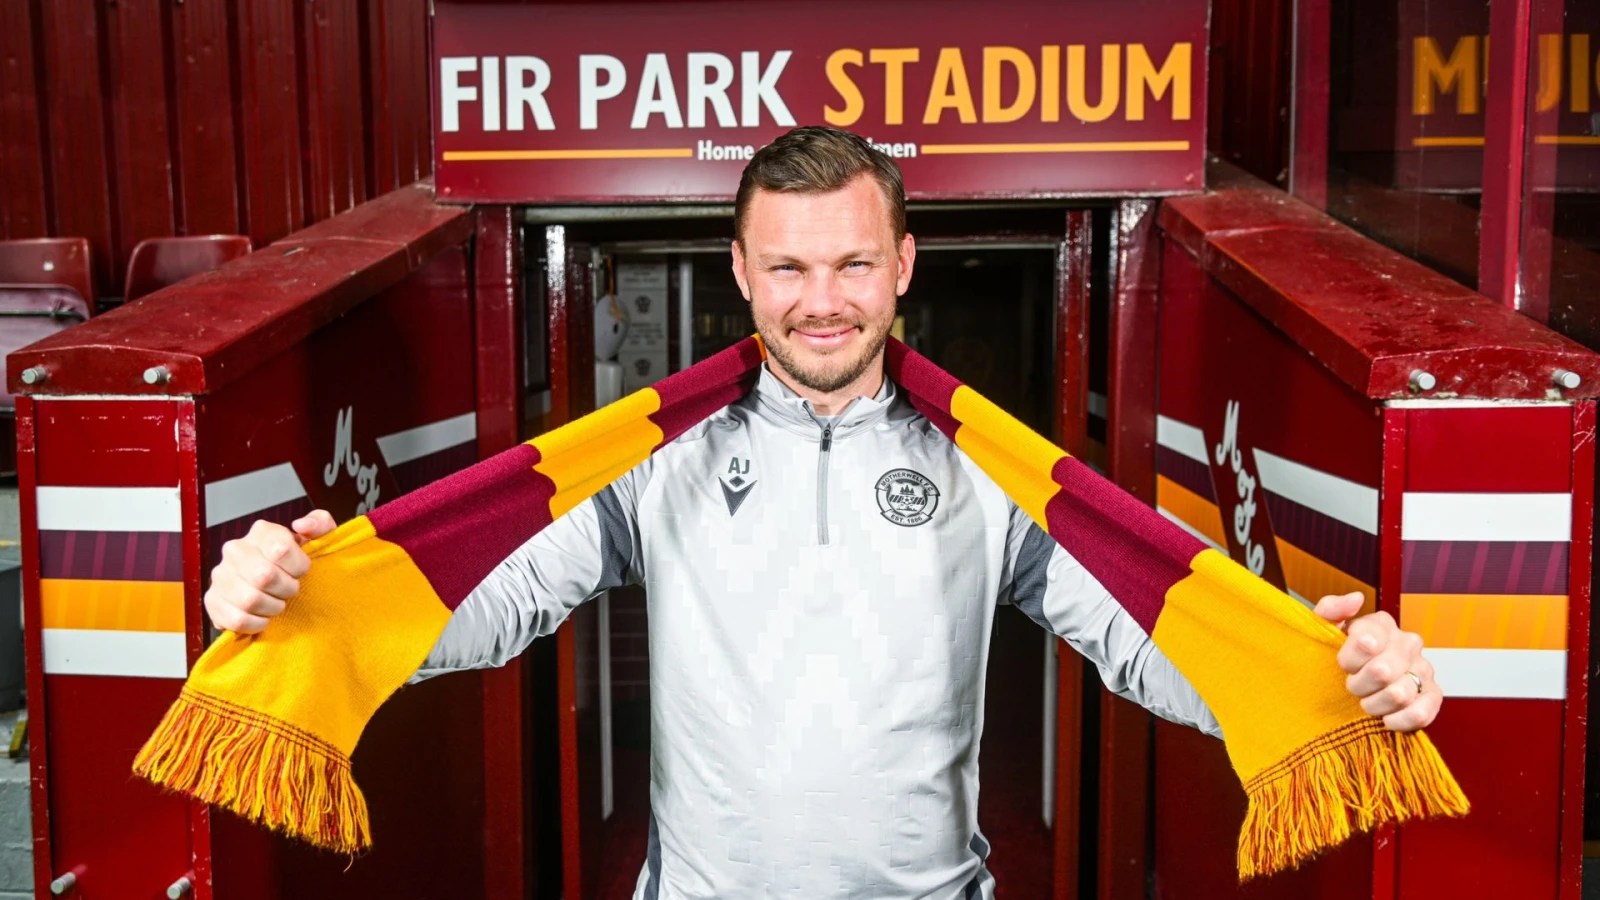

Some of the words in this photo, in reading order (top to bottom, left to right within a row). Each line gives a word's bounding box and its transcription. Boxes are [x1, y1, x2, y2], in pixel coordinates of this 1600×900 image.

[440, 55, 556, 132] FIR
[579, 50, 798, 130] PARK
[823, 42, 1192, 127] STADIUM
[697, 139, 755, 161] Home
[727, 456, 751, 475] AJ
[880, 471, 924, 487] MOTHERWELL
[923, 480, 935, 493] FC
[906, 516, 923, 524] 1886
